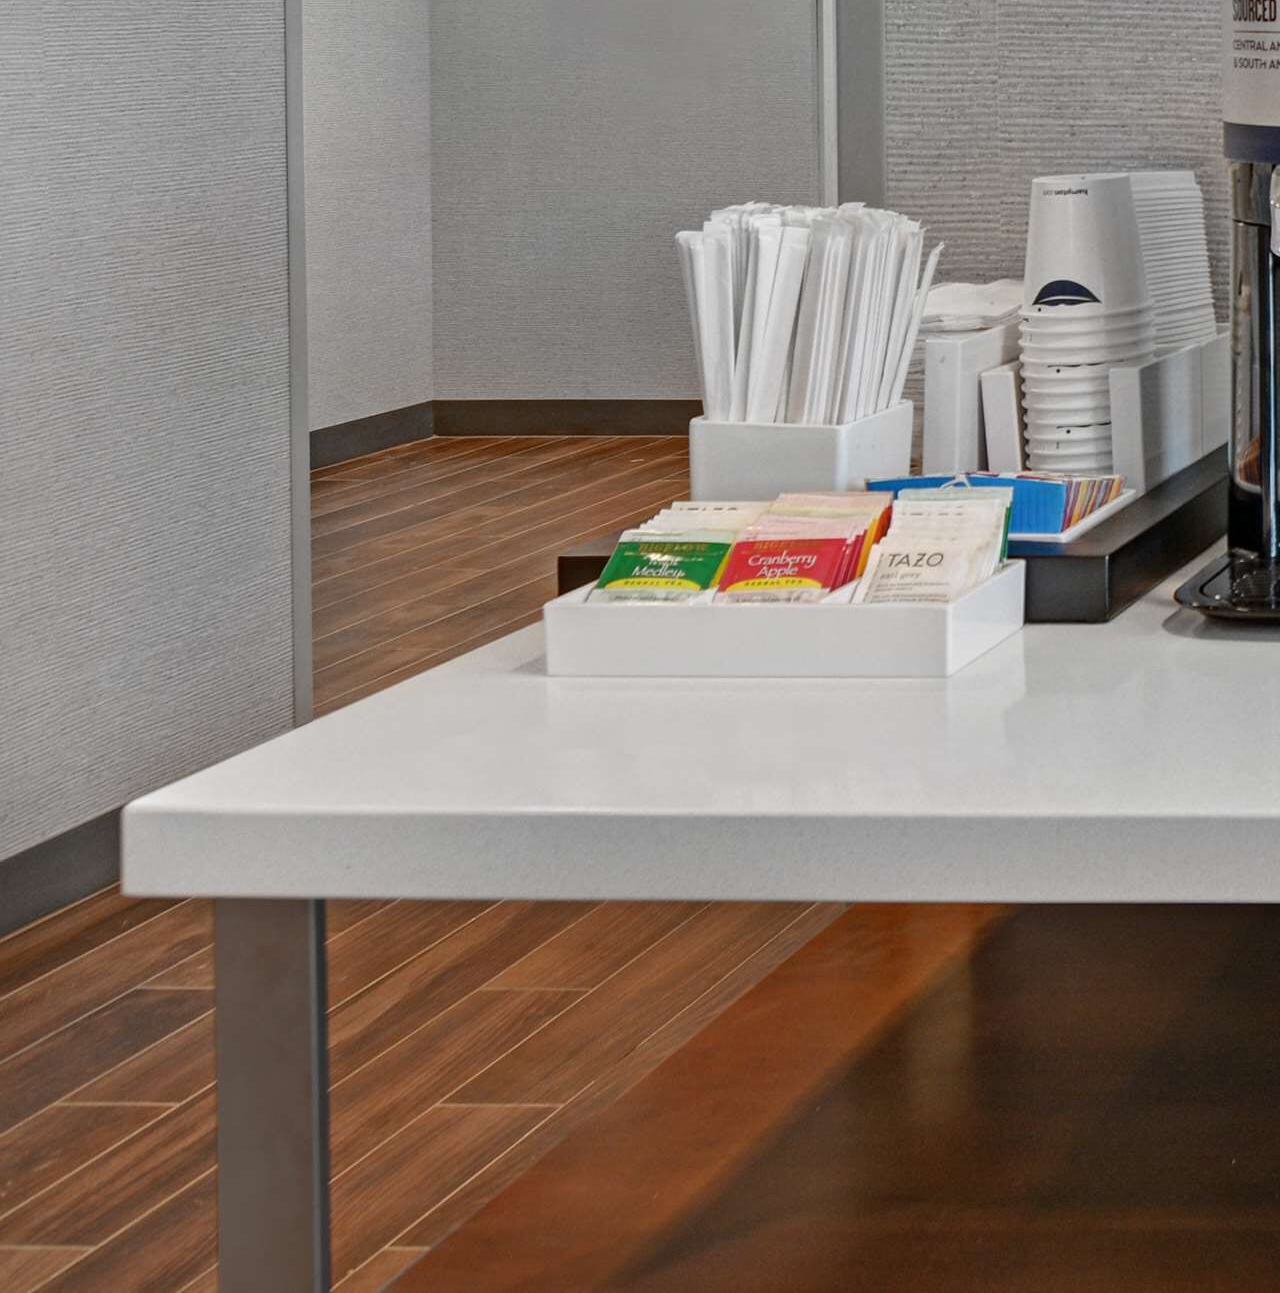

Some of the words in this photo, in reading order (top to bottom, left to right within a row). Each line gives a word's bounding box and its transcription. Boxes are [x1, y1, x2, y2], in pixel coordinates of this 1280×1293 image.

[748, 550, 817, 569] Cranberry
[888, 552, 944, 568] TAZO
[756, 562, 799, 579] Apple
